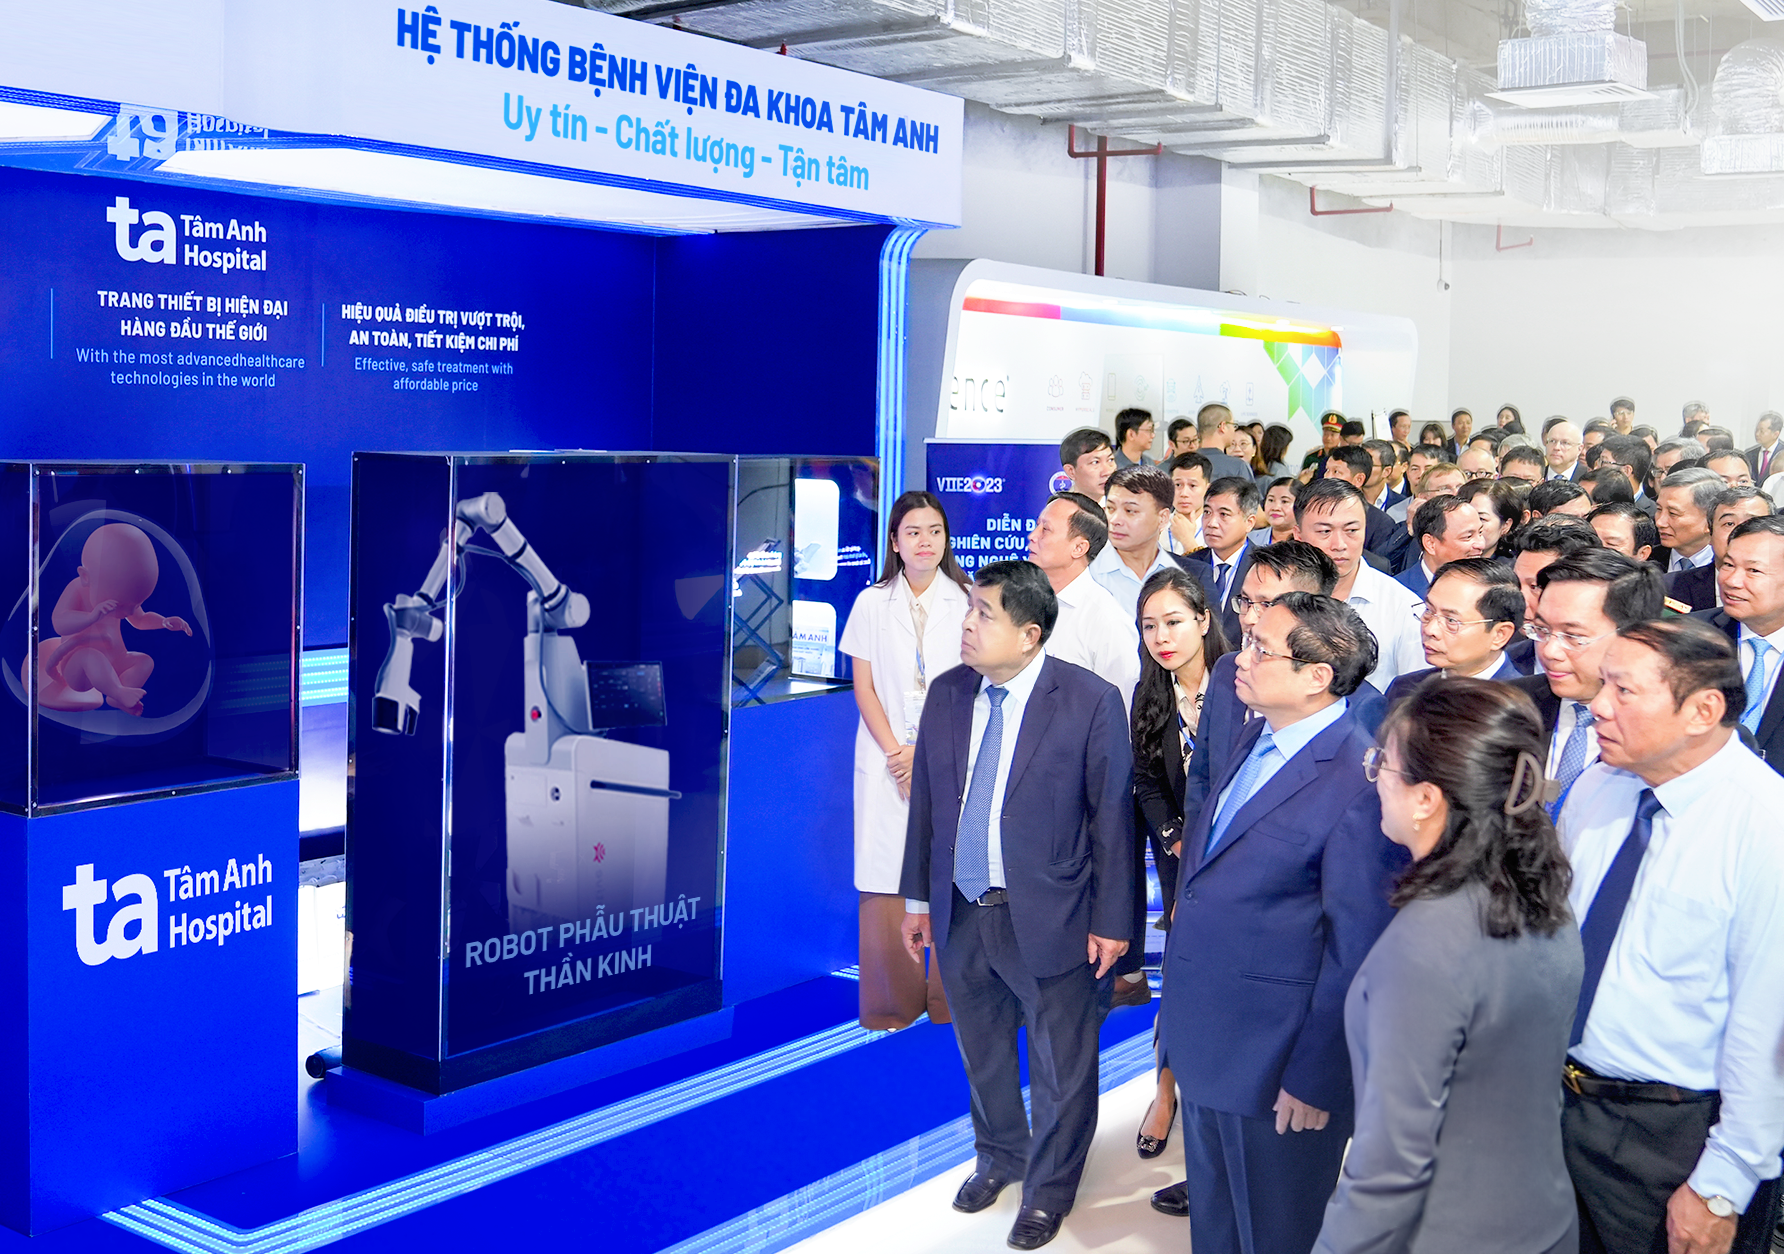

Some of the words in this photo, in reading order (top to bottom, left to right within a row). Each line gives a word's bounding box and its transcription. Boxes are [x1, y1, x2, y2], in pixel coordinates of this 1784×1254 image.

[397, 5, 441, 65] HỆ
[450, 21, 561, 77] THỐNG
[568, 42, 648, 97] BỆNH
[654, 63, 718, 116] VIỆN
[724, 80, 761, 119] ĐA
[767, 89, 834, 133] KHOA
[840, 101, 888, 144] TÂM
[893, 117, 939, 154] ANH
[504, 92, 542, 142] Uy
[549, 103, 588, 142] tín
[616, 114, 679, 158] Chất
[686, 127, 755, 178] lượng
[778, 144, 820, 188] Tận
[826, 155, 869, 190] tâm
[106, 196, 176, 264] ta
[180, 214, 224, 239] Tâm
[226, 219, 267, 242] Anh
[184, 244, 267, 274] Hospital
[97, 290, 154, 309] TRANG
[158, 290, 203, 311] THIẾT
[207, 297, 222, 317] BỊ
[225, 295, 259, 318] HIỆN
[263, 300, 288, 320] ĐẠI
[341, 301, 372, 324] HIỆU
[375, 303, 402, 322] QUẢ
[405, 303, 435, 324] ĐIỀU
[437, 310, 458, 329] TRỊ
[460, 310, 493, 330] VƯỢT
[495, 311, 525, 332] TRỘI,
[121, 317, 166, 337] HÀNG
[170, 316, 202, 338] ĐẦU
[206, 319, 237, 340] THẾ
[238, 322, 268, 341] GIỚI
[349, 330, 369, 345] AN
[372, 329, 412, 349] TOÀN,
[415, 330, 444, 348] TIẾT
[446, 332, 475, 353] KIỆM
[477, 336, 497, 351] CHI
[499, 335, 519, 352] PHÍ
[76, 348, 109, 363] With
[113, 349, 136, 364] the
[139, 352, 173, 365] most
[177, 351, 305, 369] advancedhealthcare
[355, 357, 409, 373] Effective,
[411, 359, 434, 372] safe
[437, 361, 489, 374] treatment
[491, 362, 513, 375] with
[110, 370, 199, 388] technologies
[202, 372, 214, 386] in
[217, 372, 238, 387] the
[241, 373, 276, 388] world
[393, 377, 449, 391] affordable
[452, 379, 479, 393] price
[987, 513, 1021, 531] DIỄN
[994, 534, 1029, 551] CỨU,
[808, 634, 827, 642] ANH
[164, 865, 219, 902] Tâm
[222, 853, 272, 891] Anh
[62, 863, 158, 966] ta
[169, 895, 272, 949] Hospital
[465, 926, 553, 968] ROBOT
[559, 904, 624, 948] PHẪU
[629, 894, 700, 932] THUẬT
[523, 952, 592, 995] THẦN
[597, 944, 652, 979] KINH
